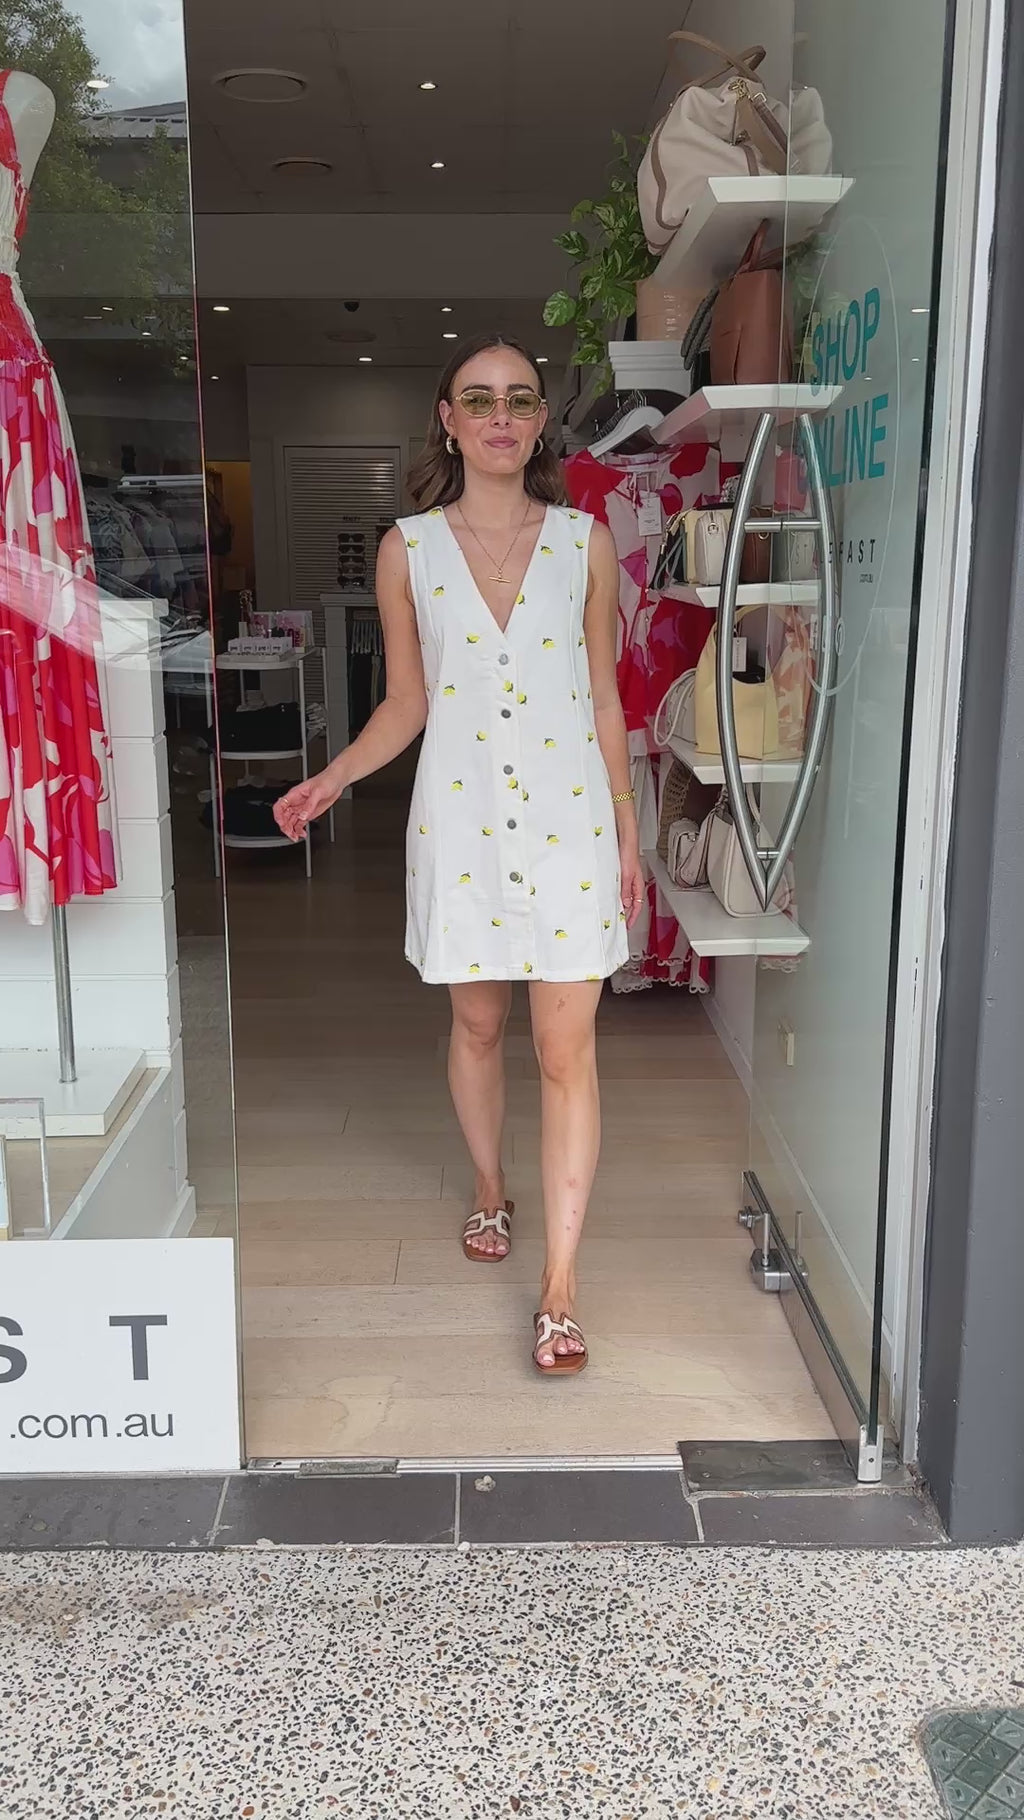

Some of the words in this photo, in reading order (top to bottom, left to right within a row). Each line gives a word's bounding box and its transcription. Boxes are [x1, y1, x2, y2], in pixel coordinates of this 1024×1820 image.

[810, 287, 880, 397] SHOP
[798, 393, 888, 494] NLINE
[10, 1413, 174, 1439] .com.au
